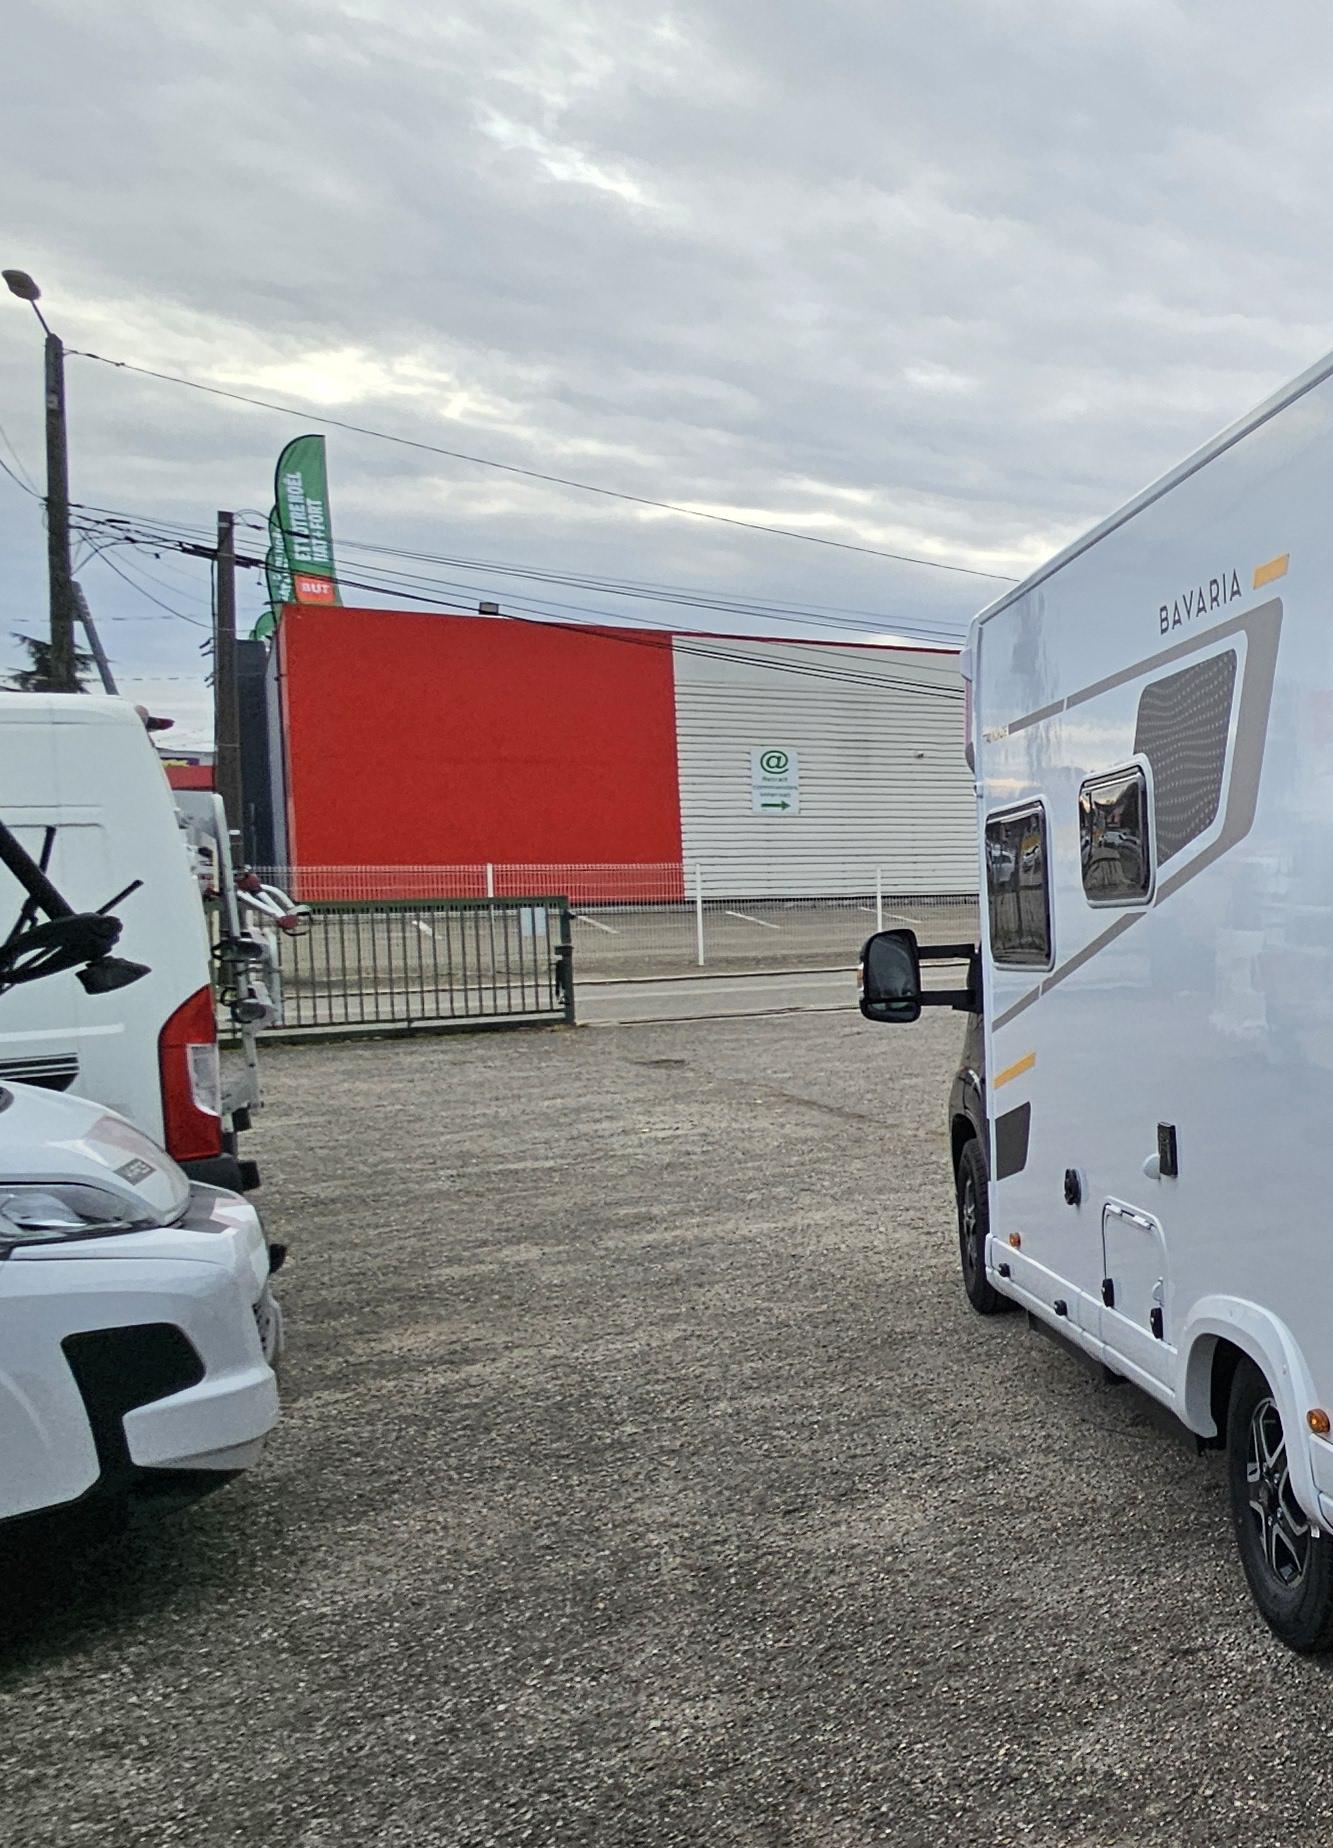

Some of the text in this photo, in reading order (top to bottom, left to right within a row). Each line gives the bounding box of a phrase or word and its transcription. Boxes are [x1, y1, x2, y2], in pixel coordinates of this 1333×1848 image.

[307, 498, 326, 529] FORT
[301, 582, 330, 594] BUT
[1159, 568, 1242, 635] BAVARIA
